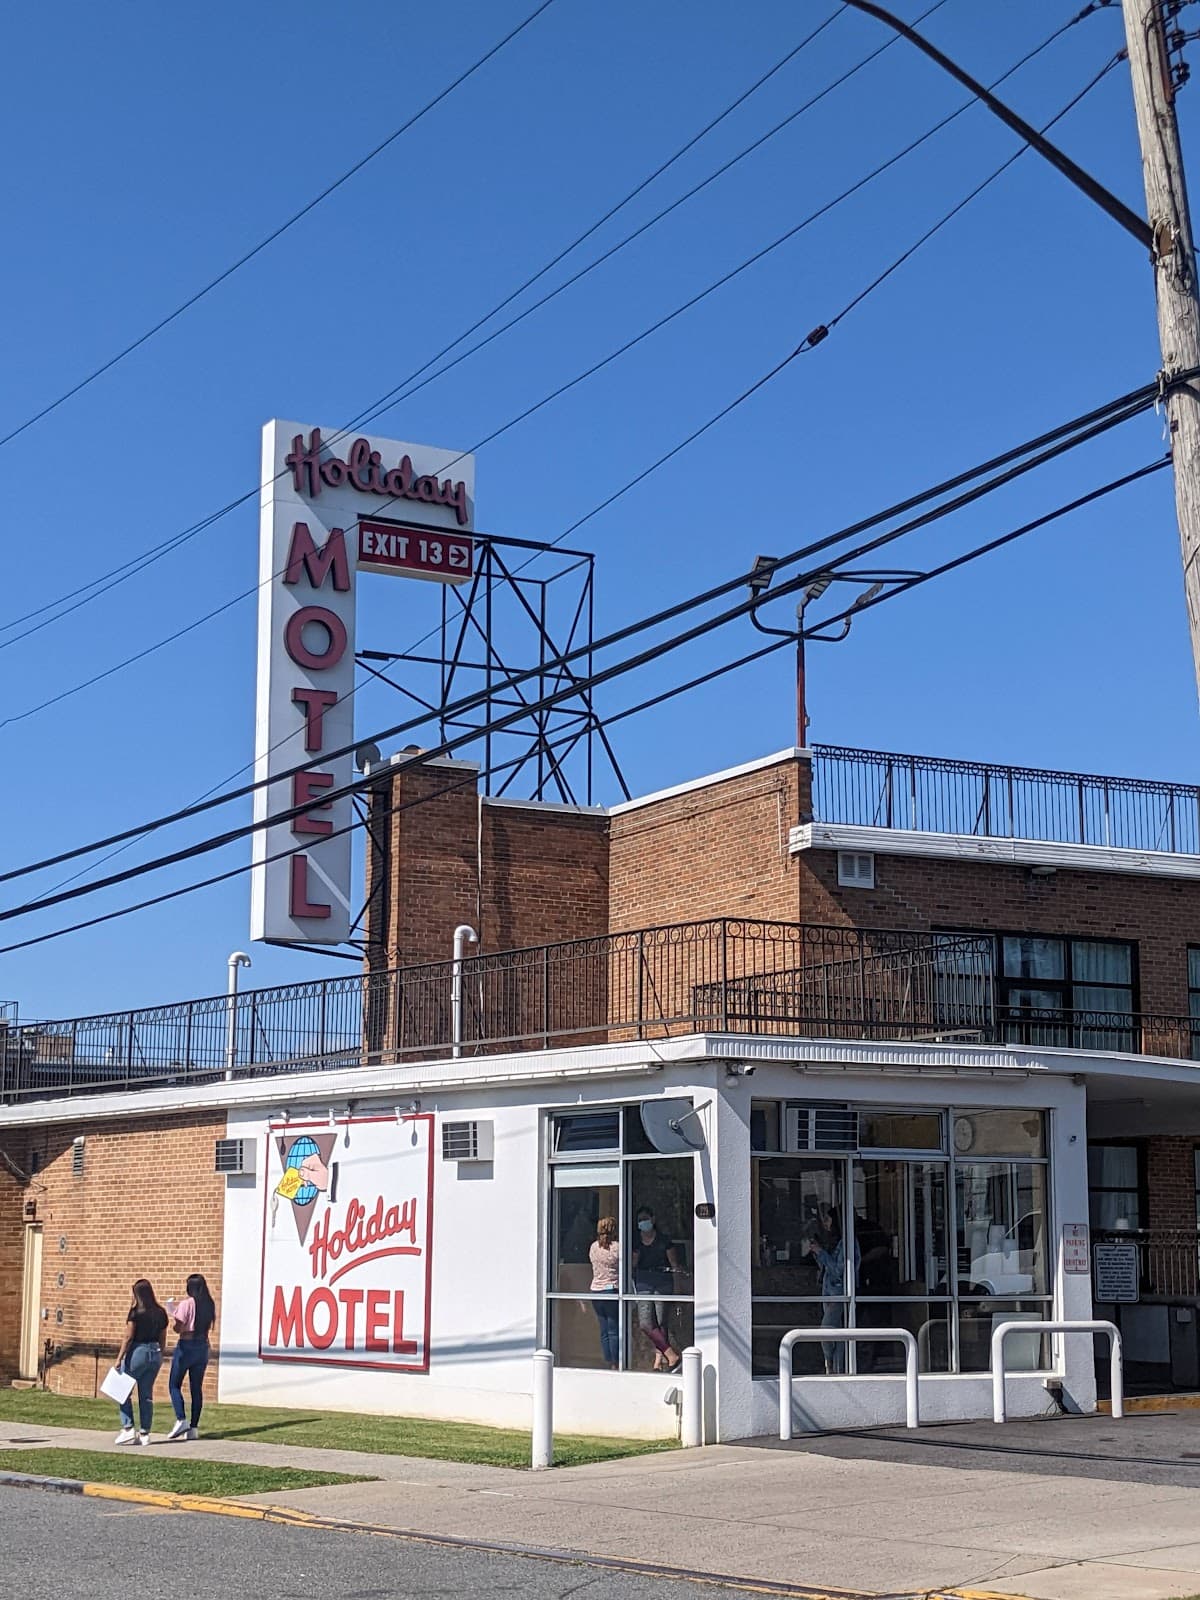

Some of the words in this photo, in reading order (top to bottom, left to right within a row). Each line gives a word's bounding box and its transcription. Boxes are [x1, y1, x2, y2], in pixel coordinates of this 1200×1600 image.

[286, 427, 468, 525] Holiday
[362, 531, 409, 559] EXIT
[419, 540, 443, 565] 13
[282, 521, 351, 919] MOTEL
[309, 1195, 417, 1280] Holiday
[268, 1285, 418, 1355] MOTEL
